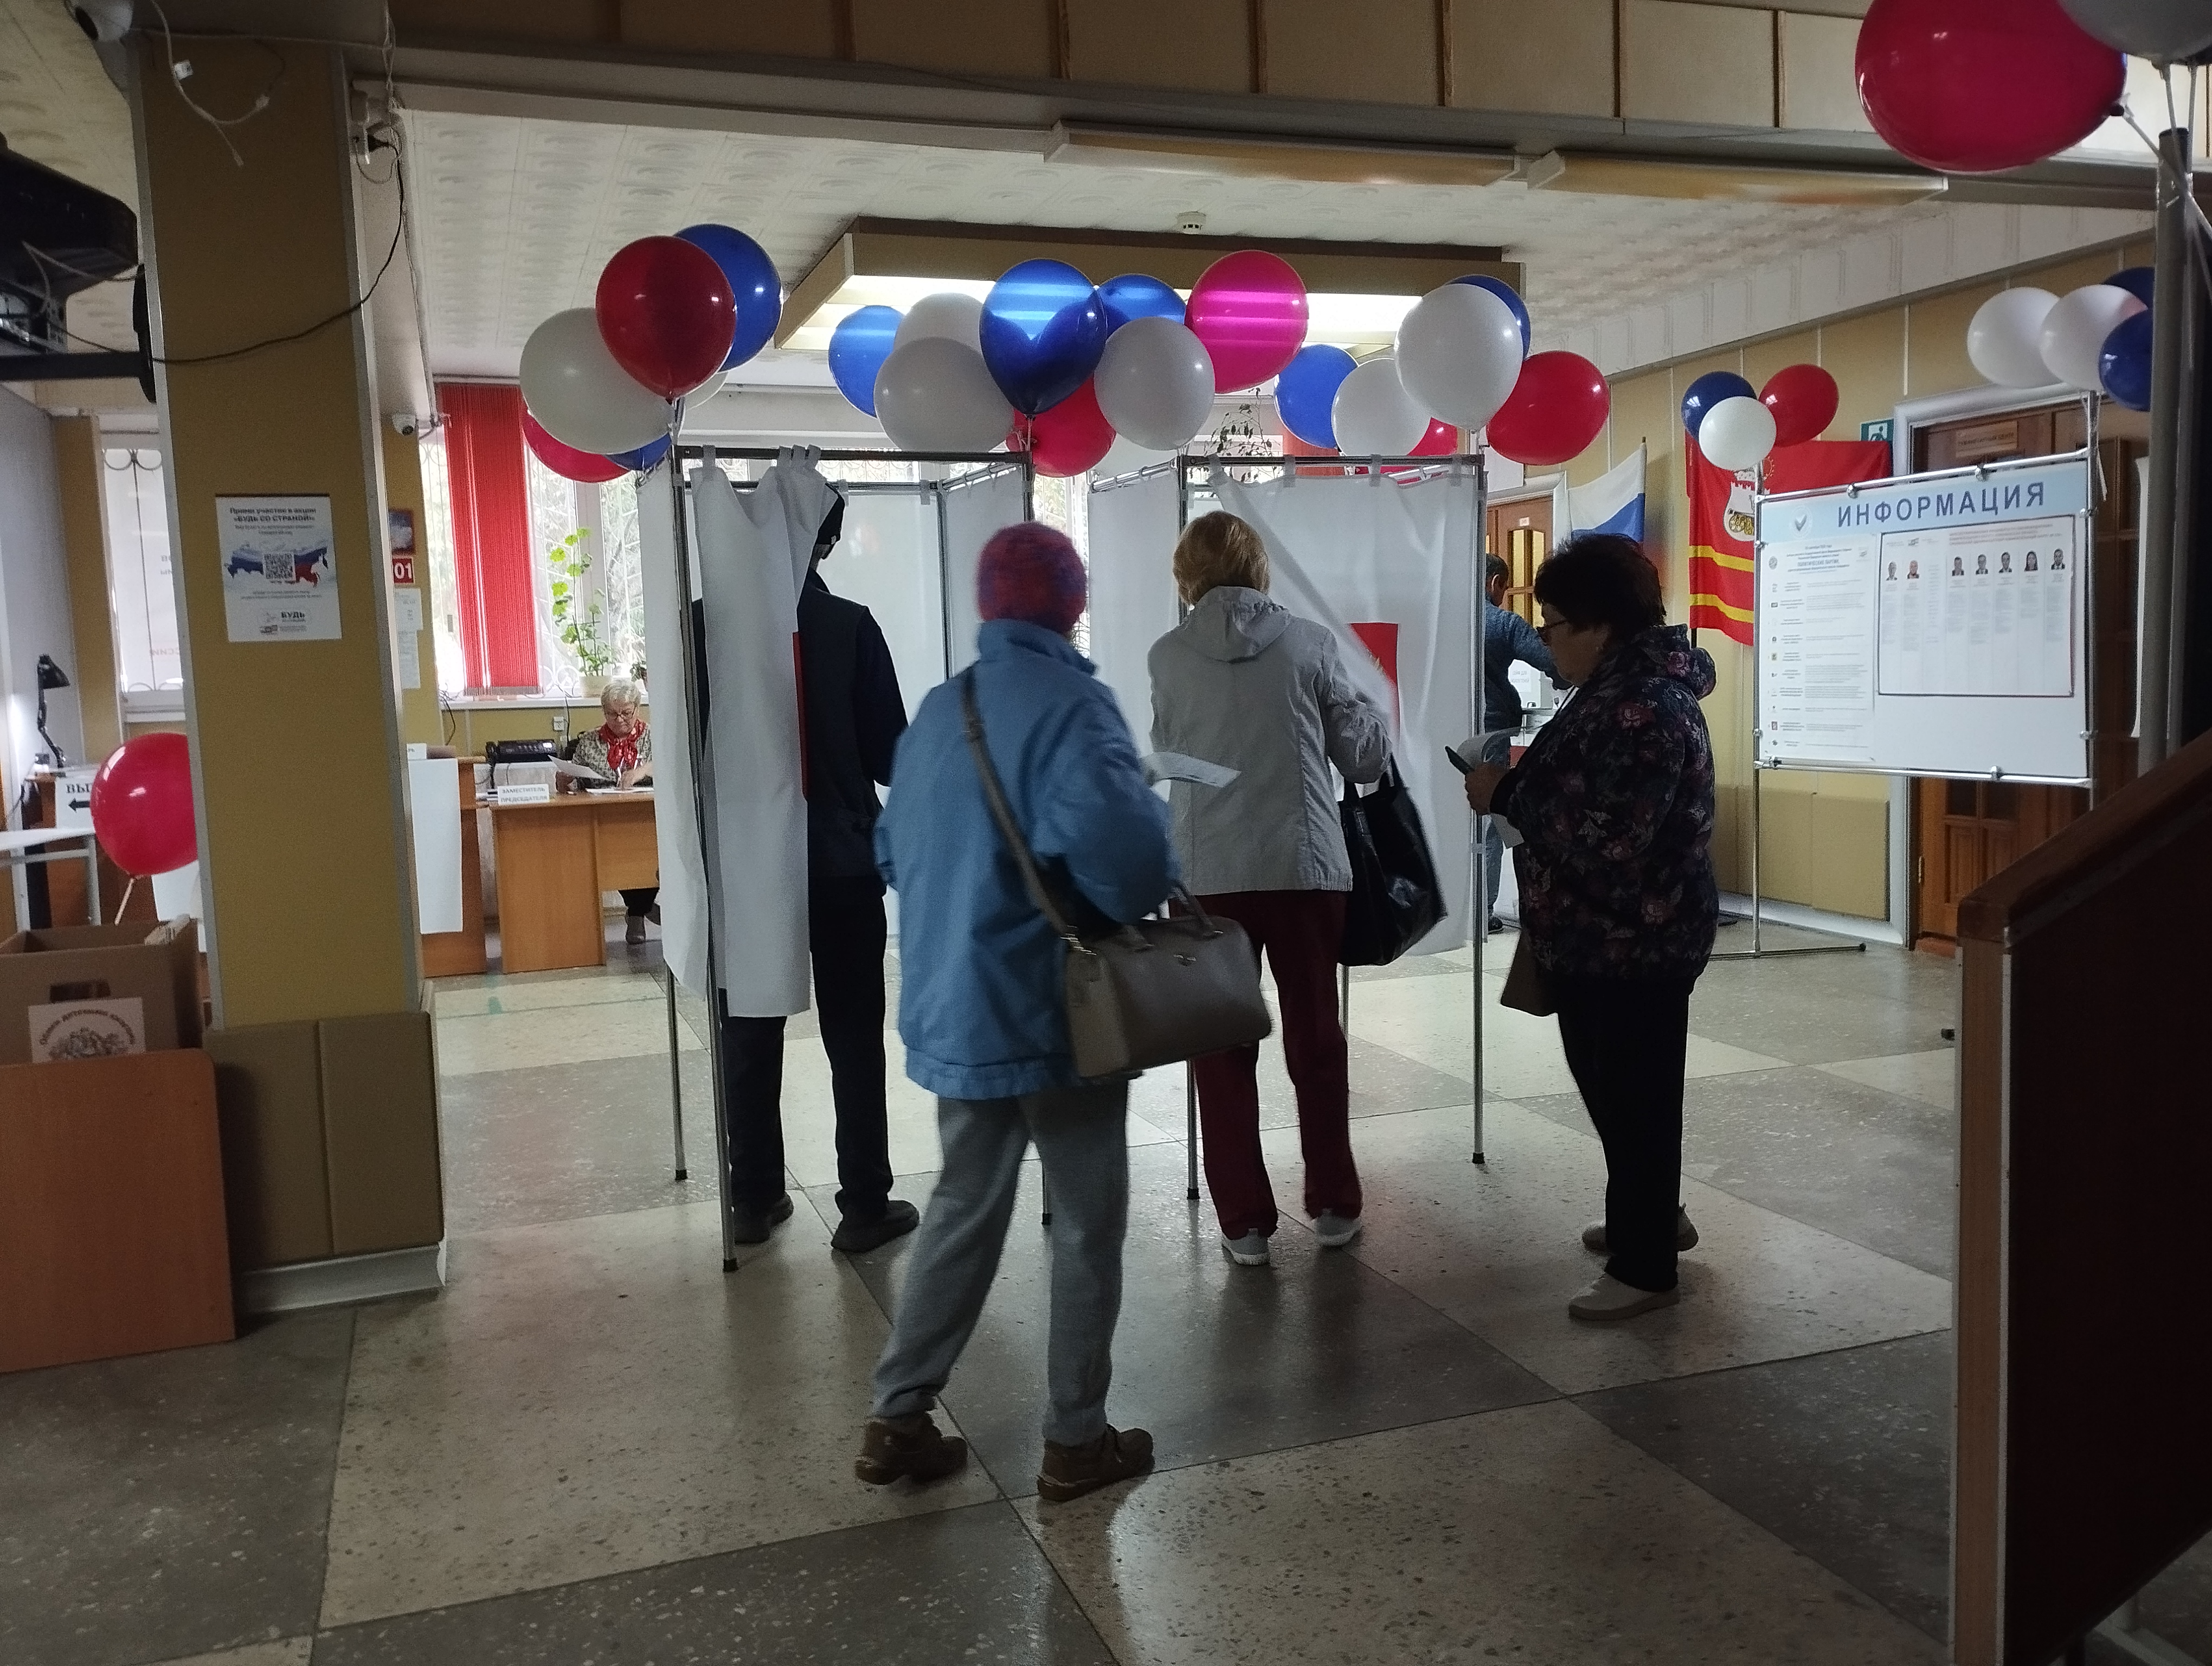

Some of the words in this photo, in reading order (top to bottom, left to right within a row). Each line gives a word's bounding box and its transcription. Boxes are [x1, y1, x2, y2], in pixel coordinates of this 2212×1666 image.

[1838, 482, 2044, 527] ИНФОРМАЦИЯ
[394, 562, 413, 579] 01
[501, 795, 548, 803] ПРЕДСЕДАТЕЛЯ
